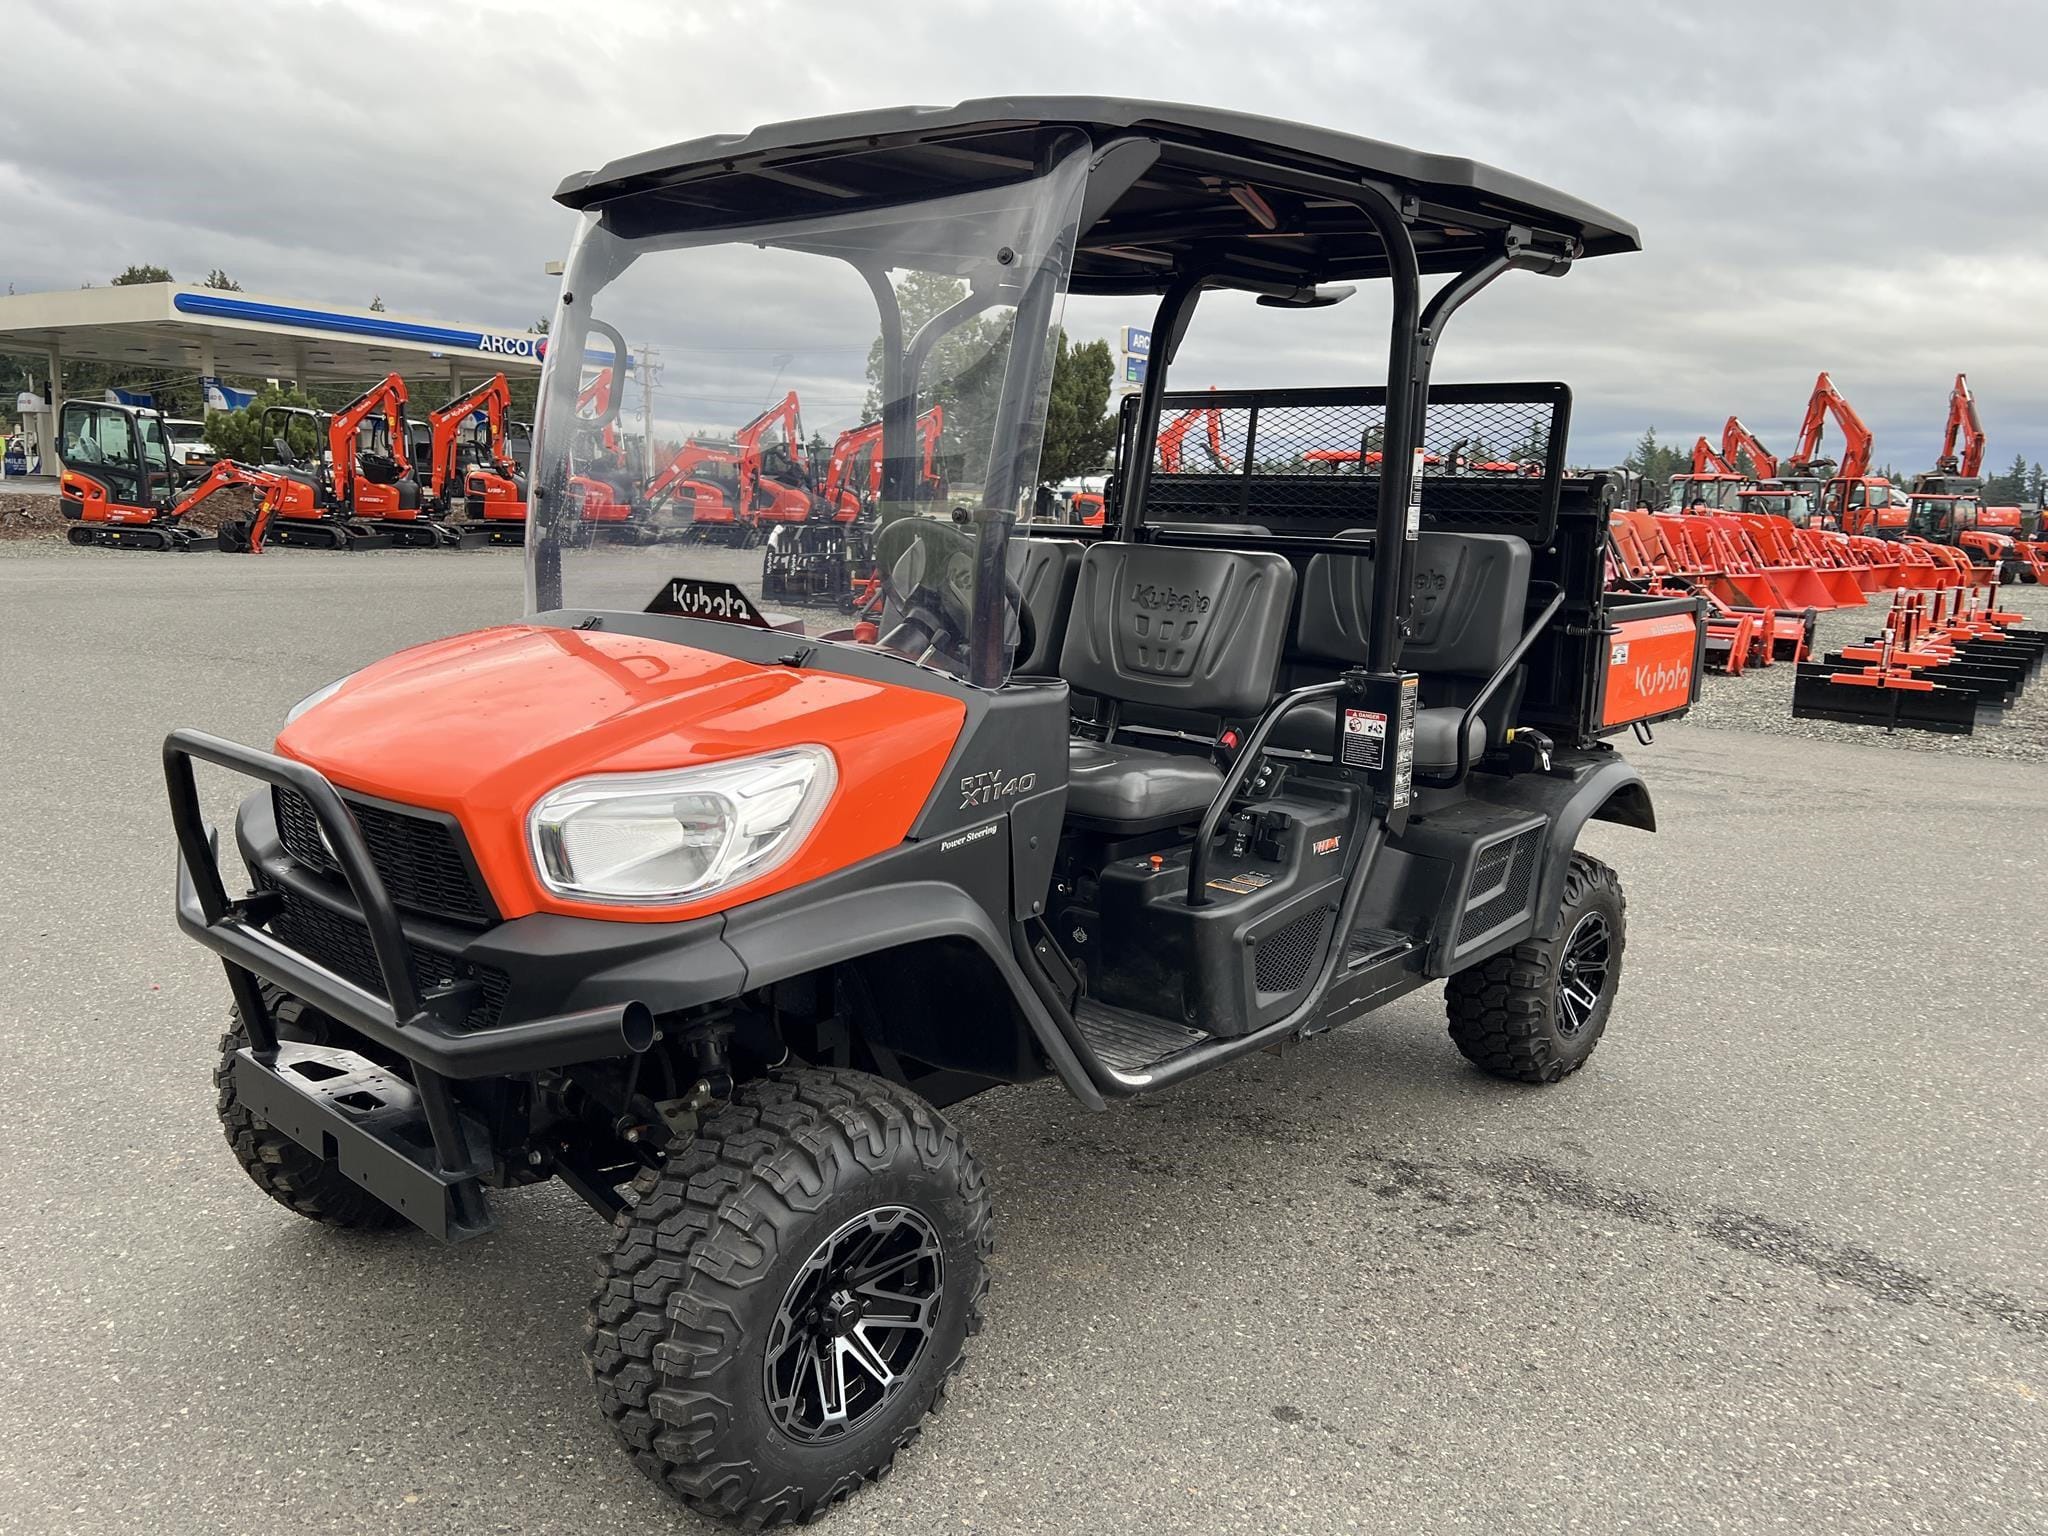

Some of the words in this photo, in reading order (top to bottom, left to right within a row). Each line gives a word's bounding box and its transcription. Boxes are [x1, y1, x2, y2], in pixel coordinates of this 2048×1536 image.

[479, 334, 529, 356] ARCO
[1133, 333, 1151, 349] ARC
[672, 583, 751, 620] Kubota
[1131, 584, 1211, 614] Kubota
[1635, 659, 1689, 697] Kubota
[1358, 712, 1380, 720] DANGER
[959, 773, 1036, 809] X1140
[961, 769, 1002, 790] RTV
[941, 836, 966, 852] Power
[966, 825, 998, 842] Steering
